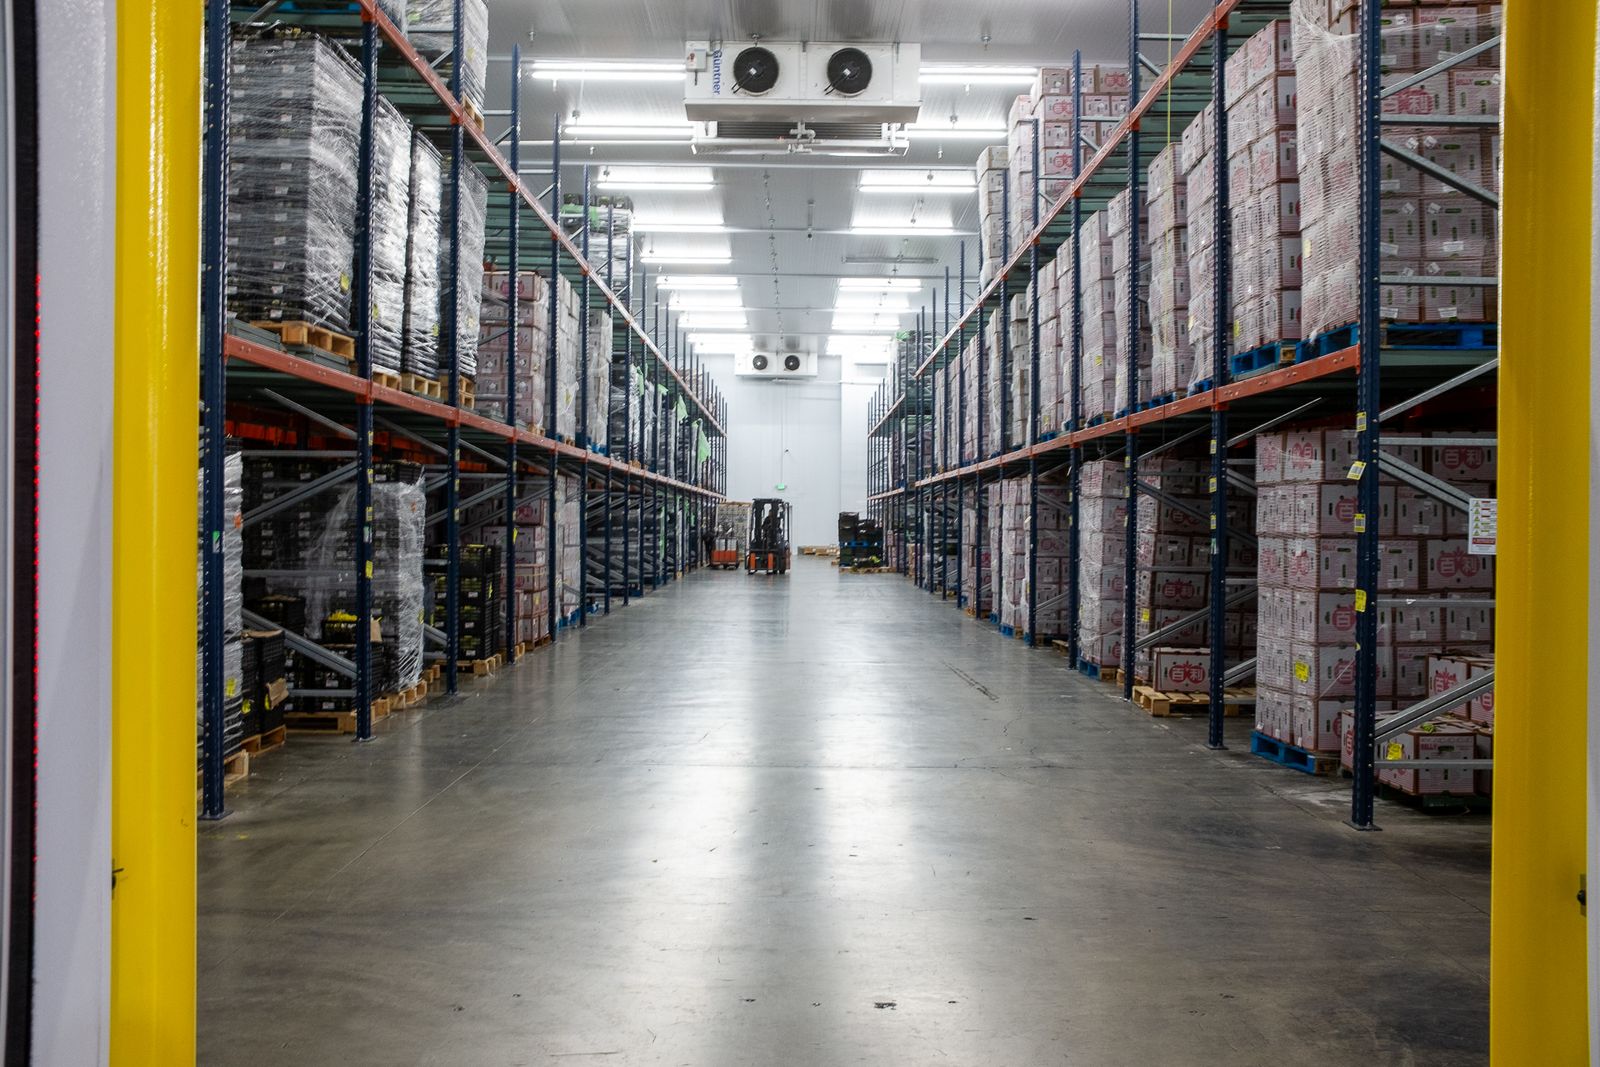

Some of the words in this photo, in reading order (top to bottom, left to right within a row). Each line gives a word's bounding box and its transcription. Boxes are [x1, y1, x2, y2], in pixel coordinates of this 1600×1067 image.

[1443, 447, 1484, 468] 百利
[1438, 555, 1479, 575] 百利
[1171, 667, 1204, 682] 百利
